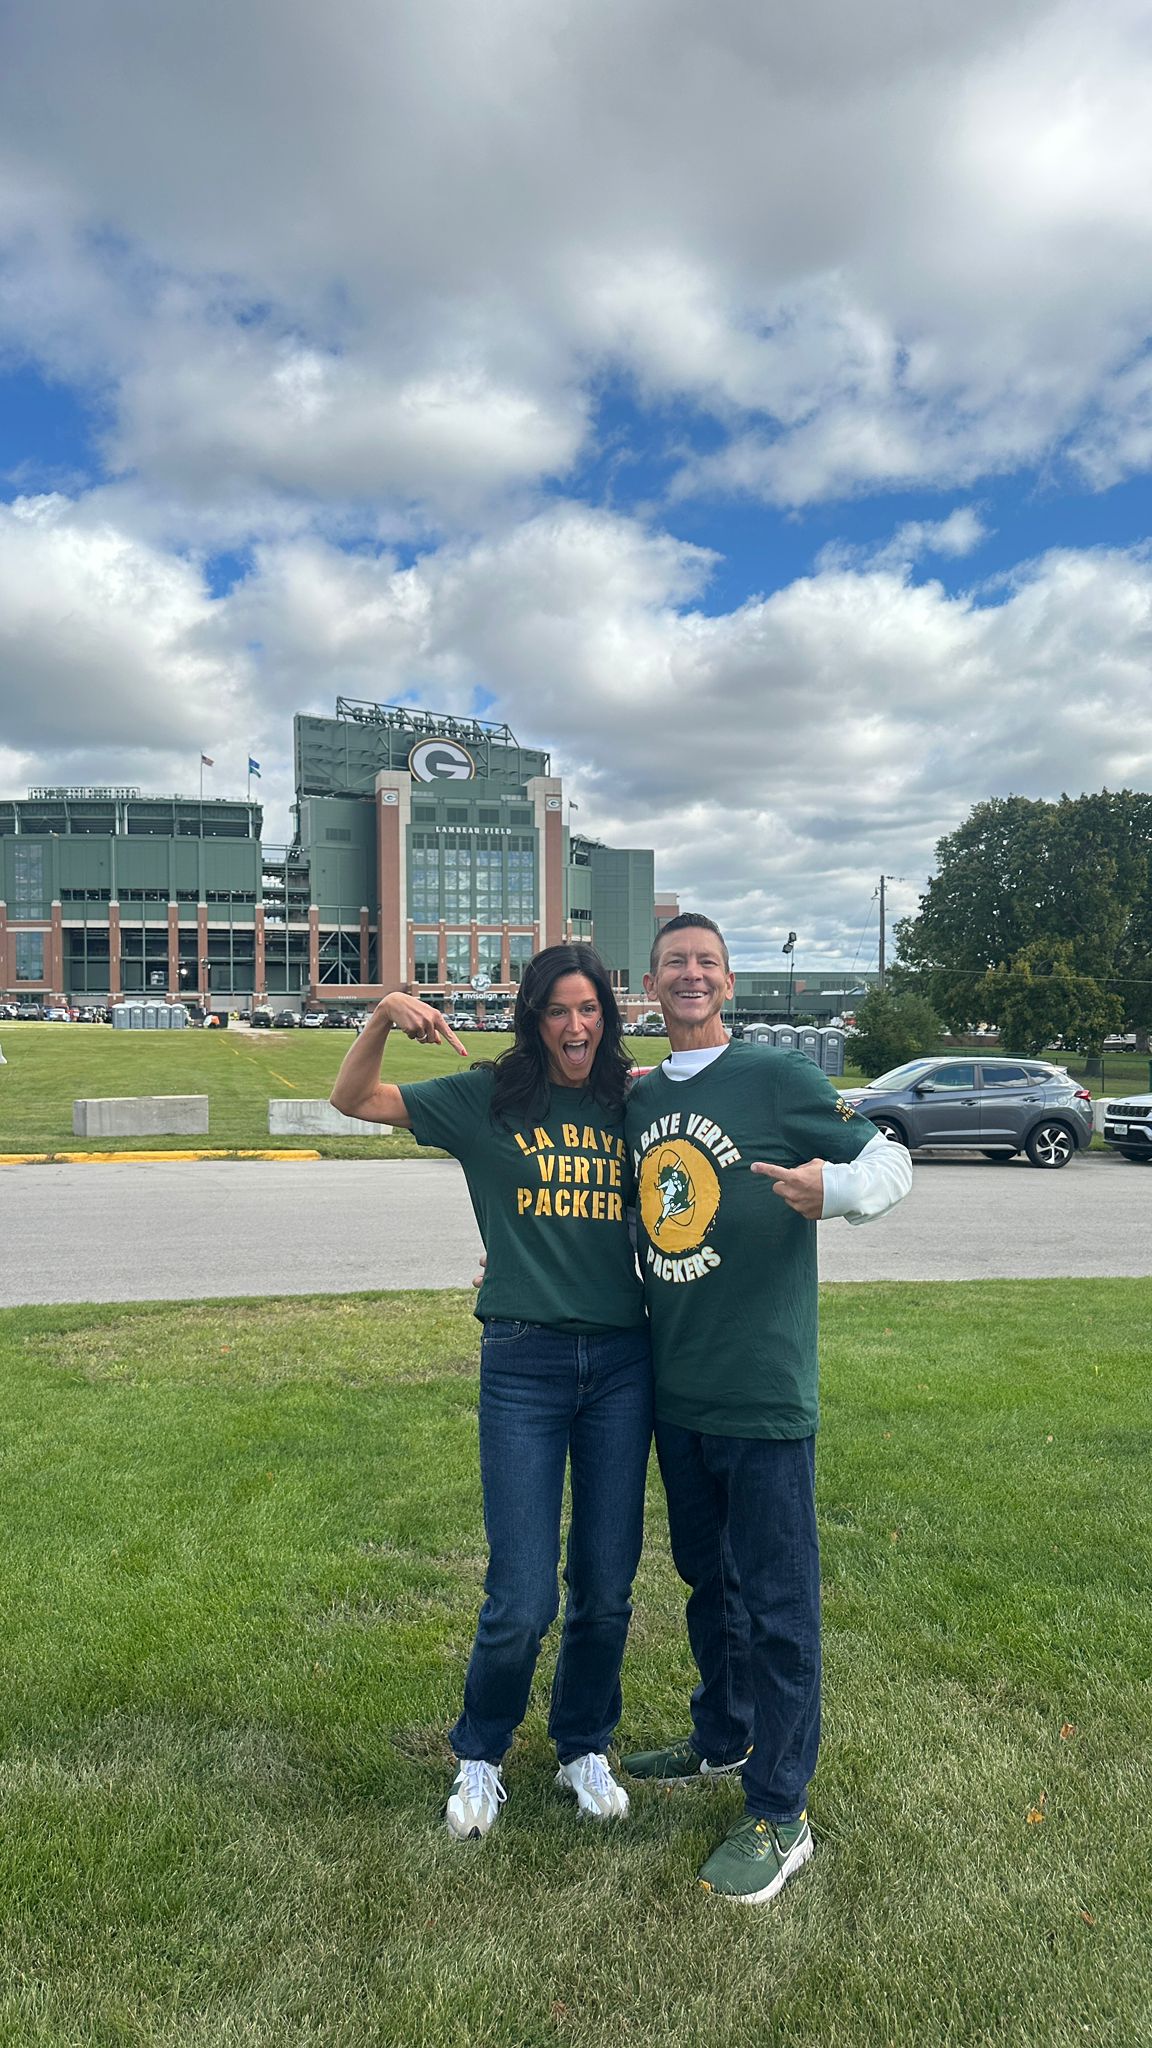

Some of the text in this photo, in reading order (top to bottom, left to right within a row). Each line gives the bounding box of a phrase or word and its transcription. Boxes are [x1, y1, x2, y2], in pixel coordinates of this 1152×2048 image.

[435, 826, 512, 835] LAMBEAU FIELD
[514, 1123, 626, 1162] LA BAYE
[640, 1112, 681, 1152] BAYE
[685, 1112, 742, 1169] VERTE
[537, 1154, 622, 1187] VERTE
[517, 1187, 623, 1221] PACKER
[646, 1245, 722, 1283] PACKERS
